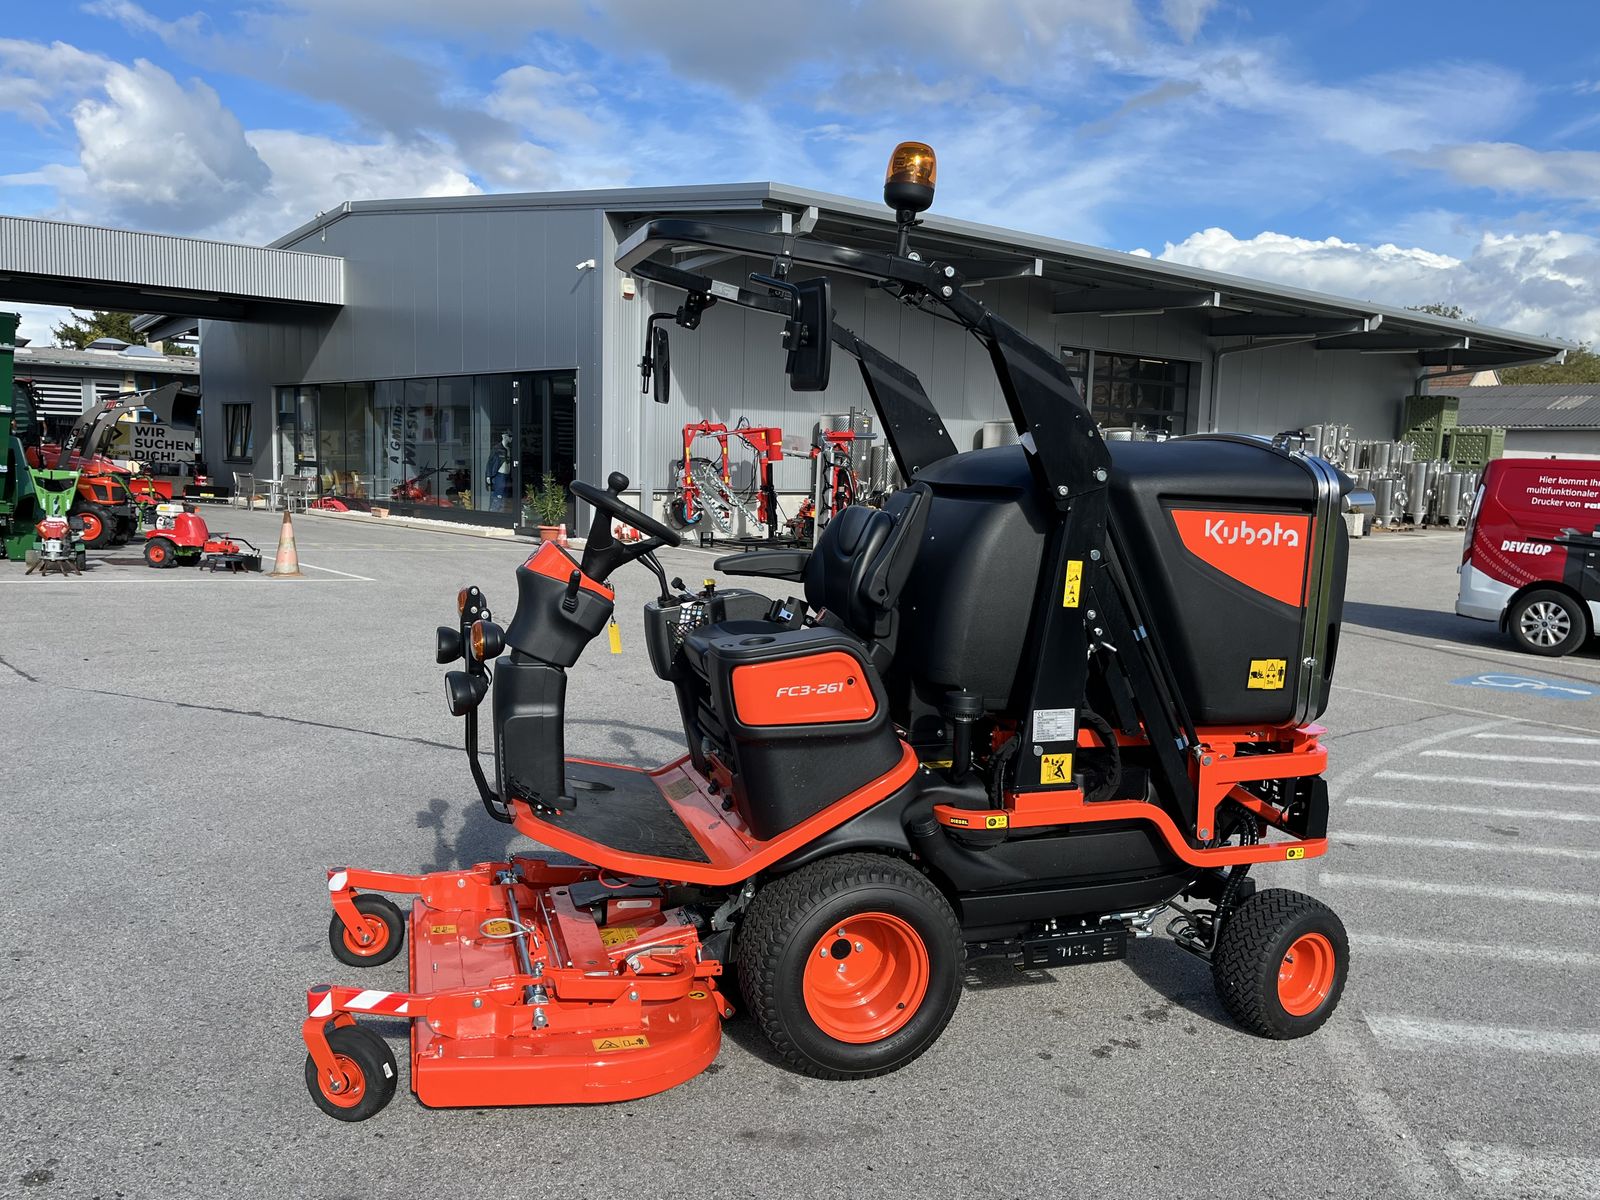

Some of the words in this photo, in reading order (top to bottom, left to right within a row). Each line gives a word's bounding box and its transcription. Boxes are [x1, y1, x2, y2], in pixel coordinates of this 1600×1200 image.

[135, 426, 165, 438] WIR
[134, 439, 194, 451] SUCHEN
[134, 450, 175, 462] DICH!
[1539, 475, 1557, 484] Hier
[1558, 476, 1588, 486] kommt
[1526, 486, 1599, 498] multifunktionaler
[1531, 497, 1564, 507] Drucker
[1565, 500, 1581, 508] von
[1204, 518, 1299, 547] Kubota
[1501, 540, 1552, 556] DEVELOP
[776, 682, 844, 698] FC3-261
